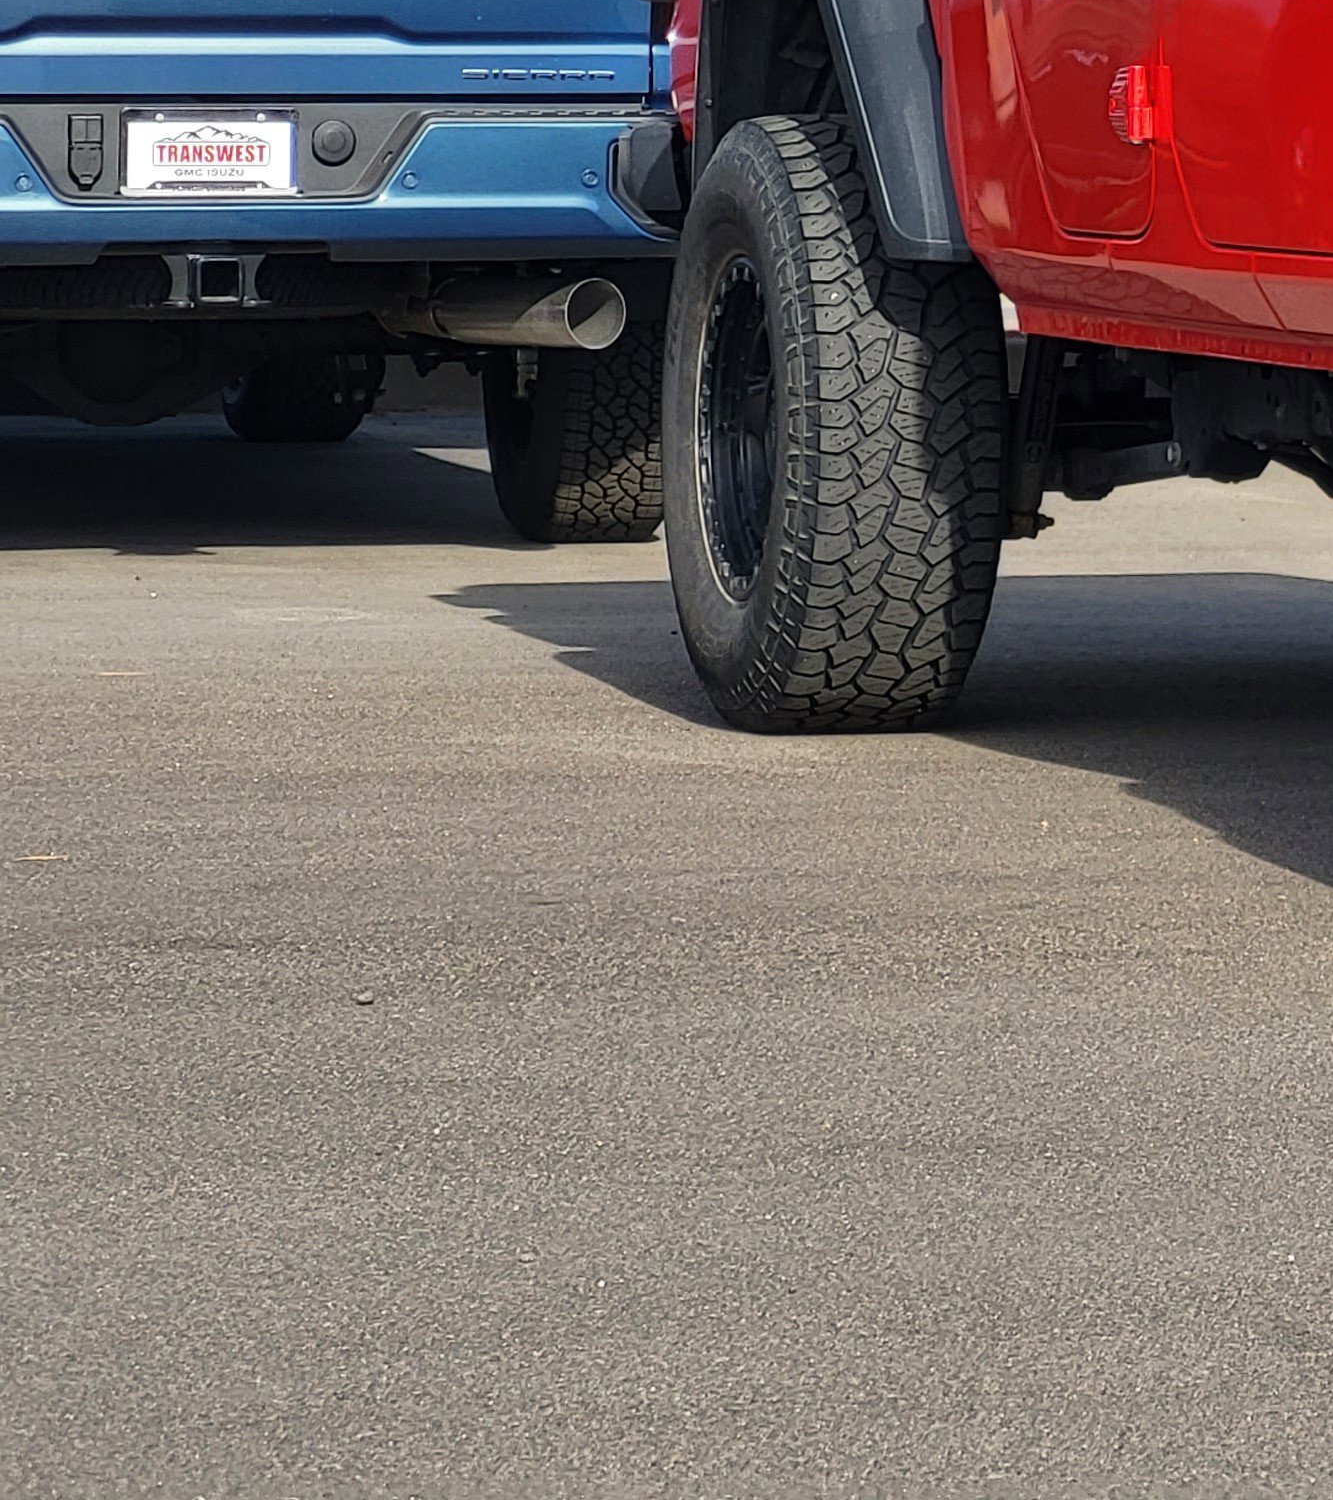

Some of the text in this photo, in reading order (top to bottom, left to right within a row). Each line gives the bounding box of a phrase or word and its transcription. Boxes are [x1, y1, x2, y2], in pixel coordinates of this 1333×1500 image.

[461, 68, 616, 81] SIERRA
[155, 144, 267, 163] TRANSWEST
[174, 168, 245, 177] GMC ISUZU
